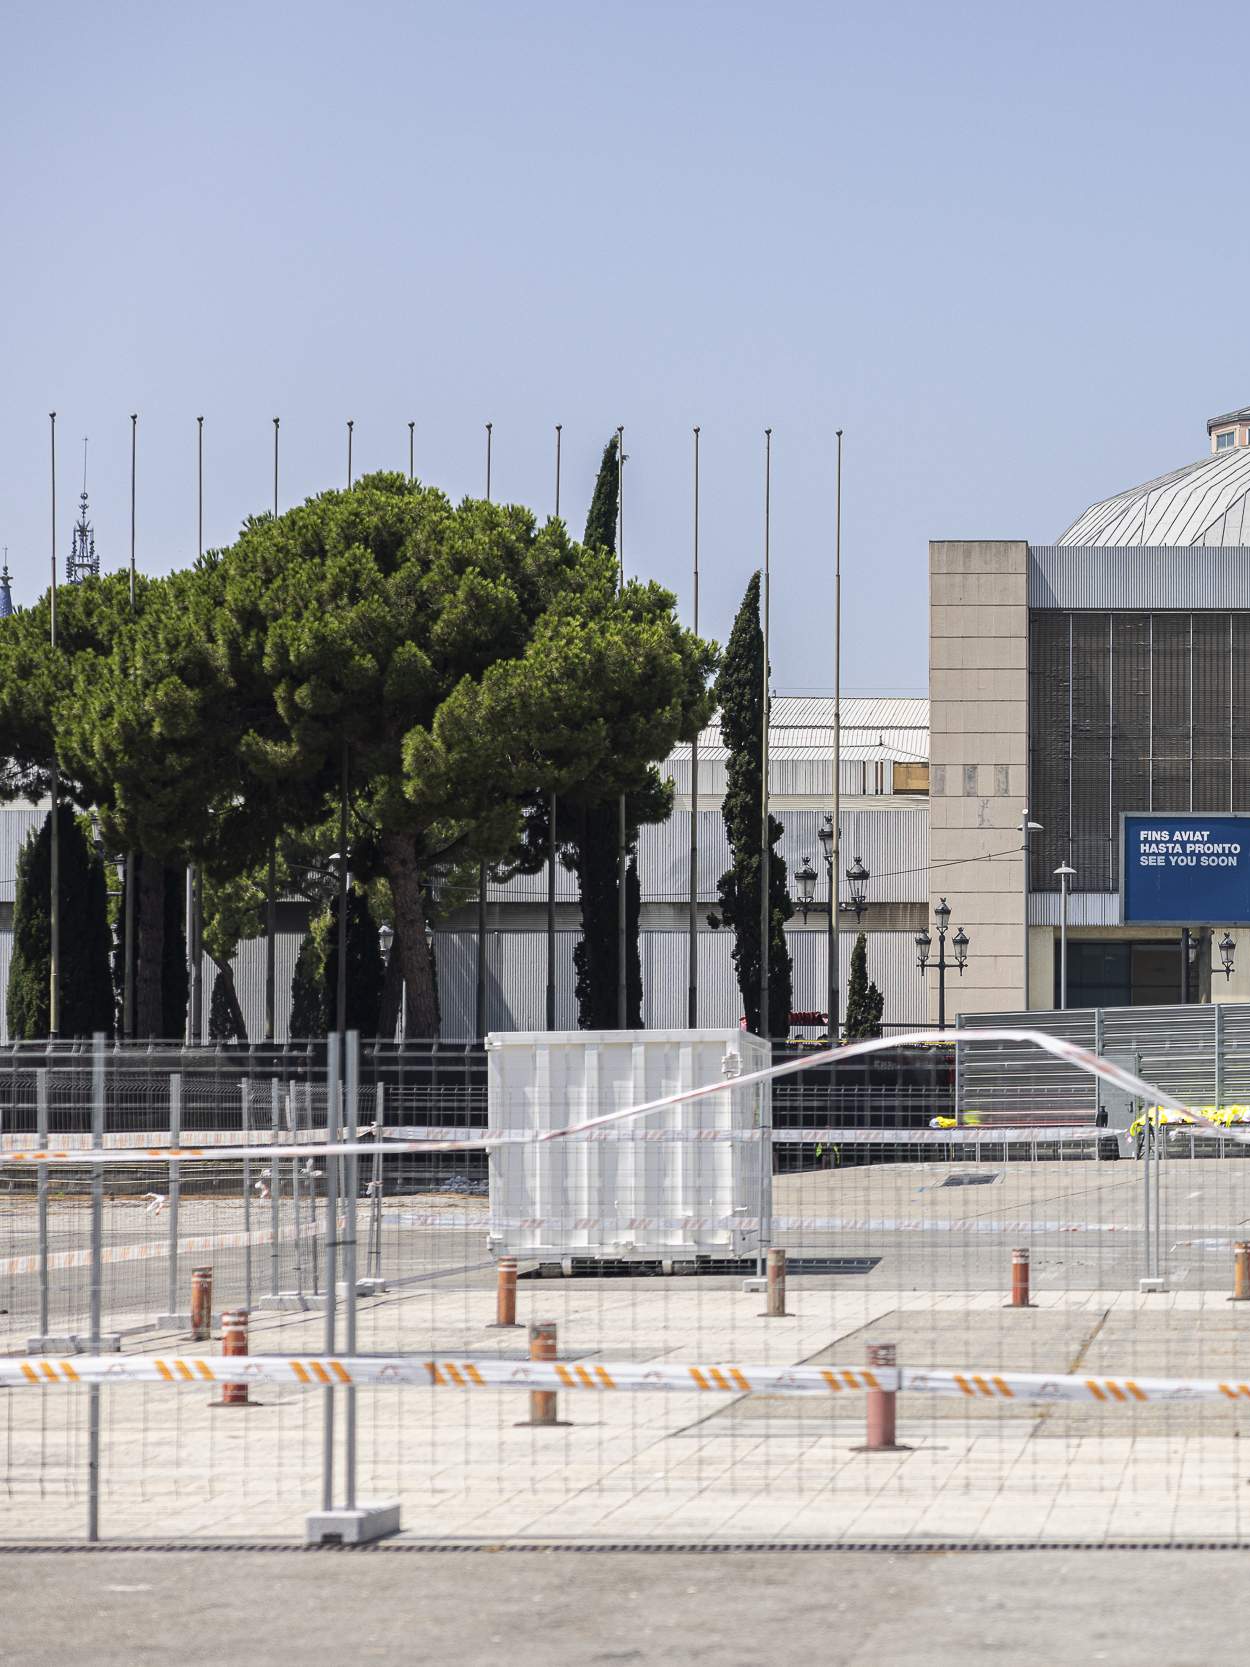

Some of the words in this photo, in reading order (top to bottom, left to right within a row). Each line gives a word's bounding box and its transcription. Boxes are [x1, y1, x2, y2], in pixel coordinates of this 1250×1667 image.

[1140, 831, 1170, 841] FINS
[1172, 831, 1210, 841] AVIAT
[1140, 843, 1183, 854] HASTA
[1186, 843, 1241, 854] PRONTO
[1140, 856, 1166, 866] SEE
[1169, 856, 1197, 866] YOU
[1200, 856, 1237, 866] SOON
